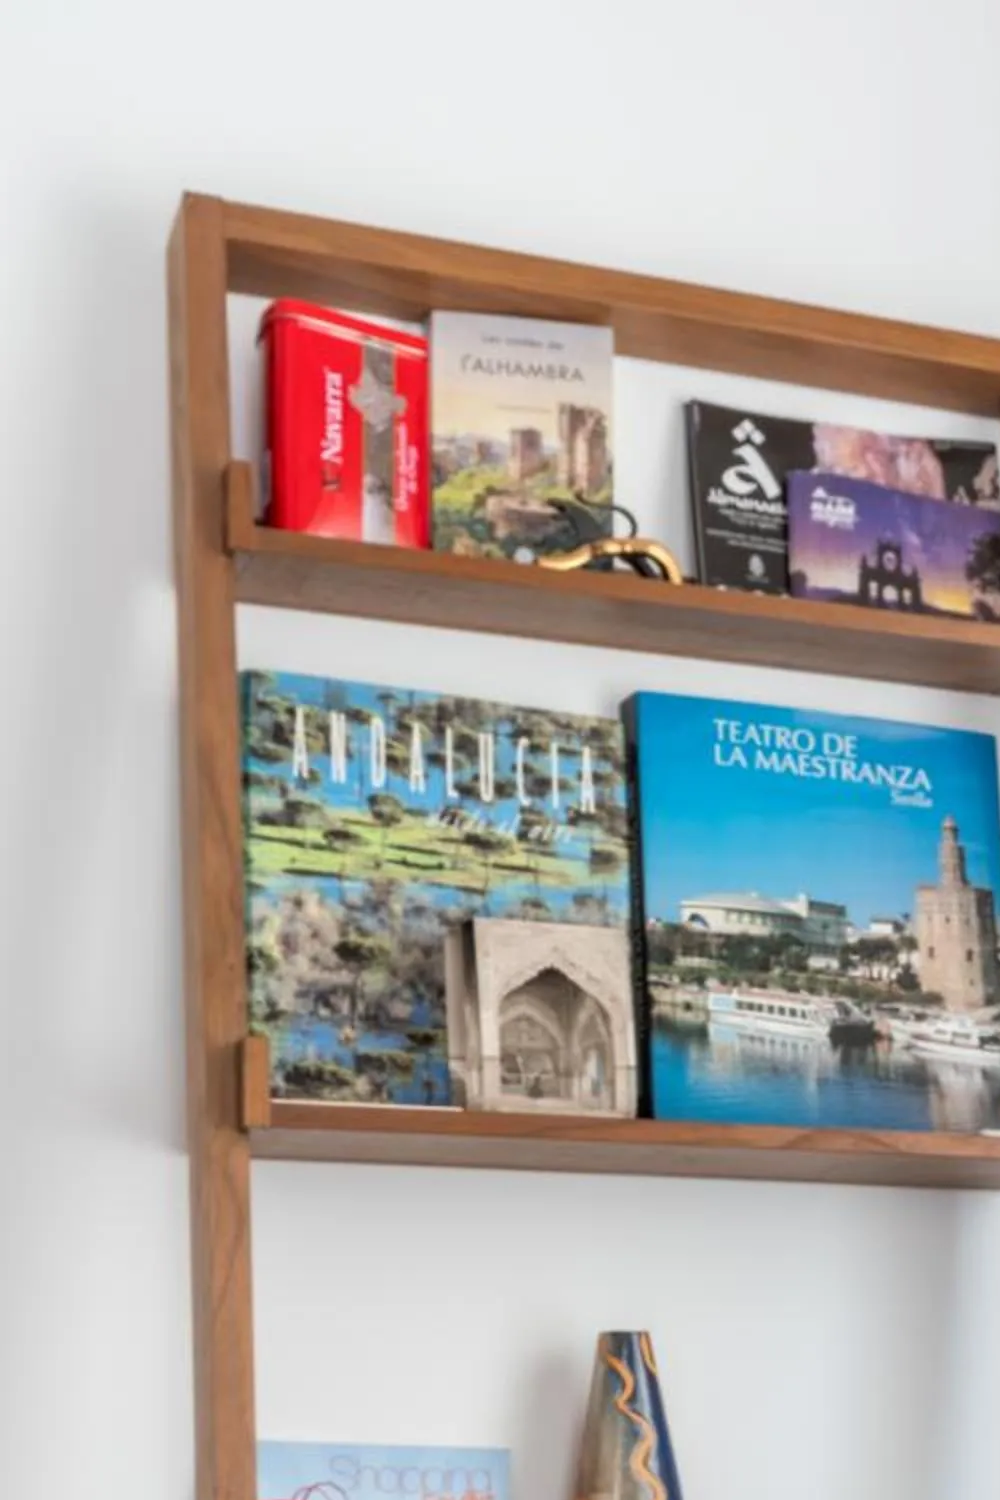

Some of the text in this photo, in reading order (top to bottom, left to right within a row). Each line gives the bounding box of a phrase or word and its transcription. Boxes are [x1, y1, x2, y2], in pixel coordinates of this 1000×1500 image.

[713, 718, 859, 759] TEATRO DE
[713, 743, 933, 792] LA MAESTRANZA
